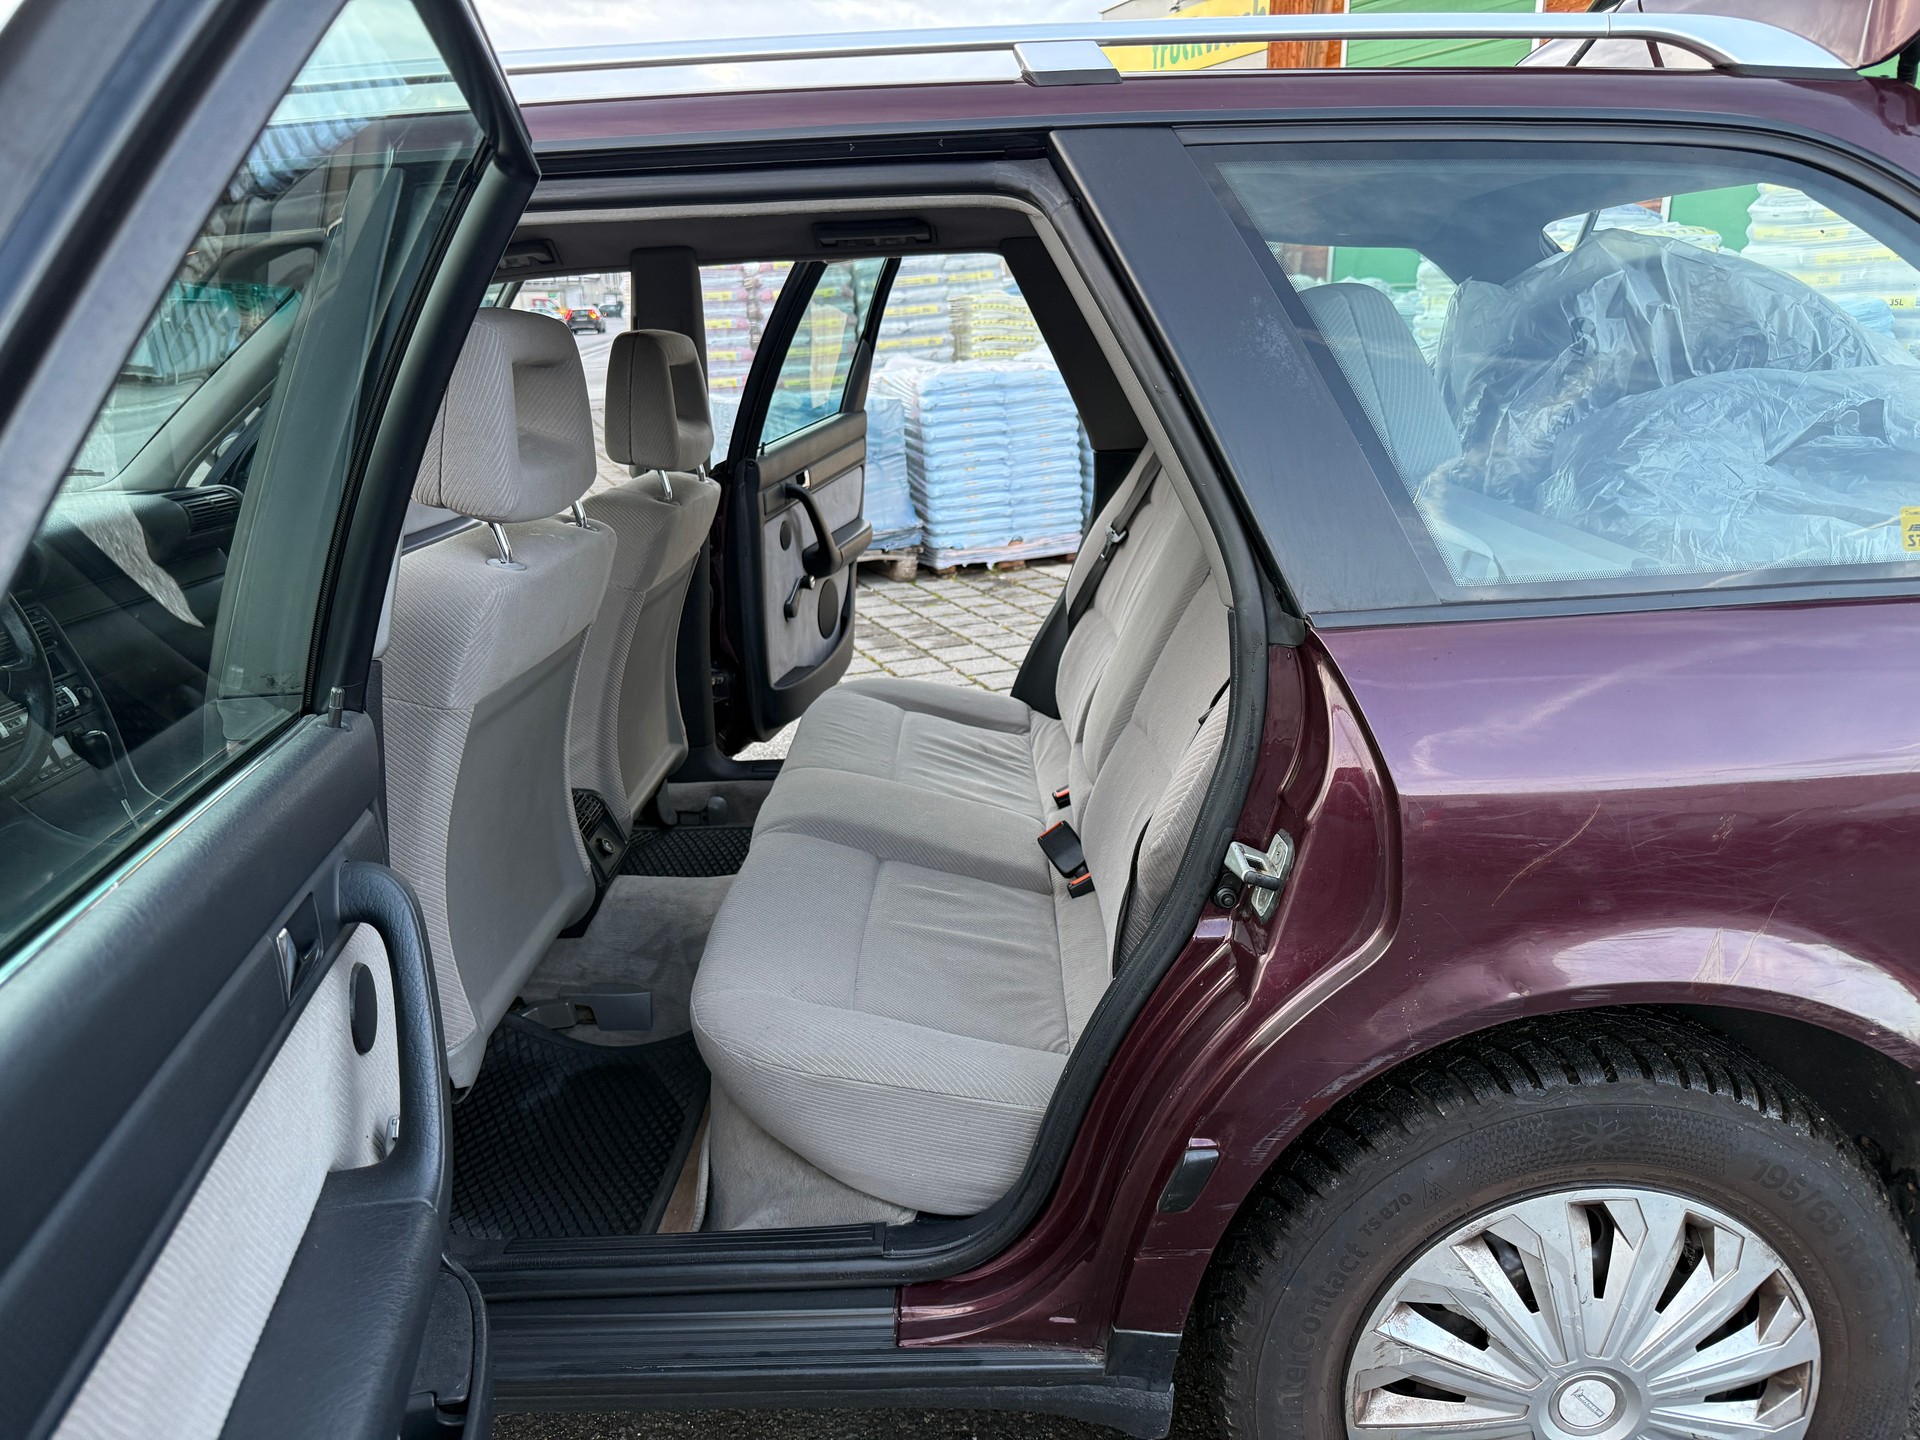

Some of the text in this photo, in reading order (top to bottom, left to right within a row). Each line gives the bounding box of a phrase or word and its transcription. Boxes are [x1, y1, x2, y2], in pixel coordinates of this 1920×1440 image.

[1889, 298, 1904, 306] 35L
[1358, 1215, 1382, 1238] TS
[1379, 1192, 1413, 1221] 870
[1750, 1158, 1848, 1238] 195/65
